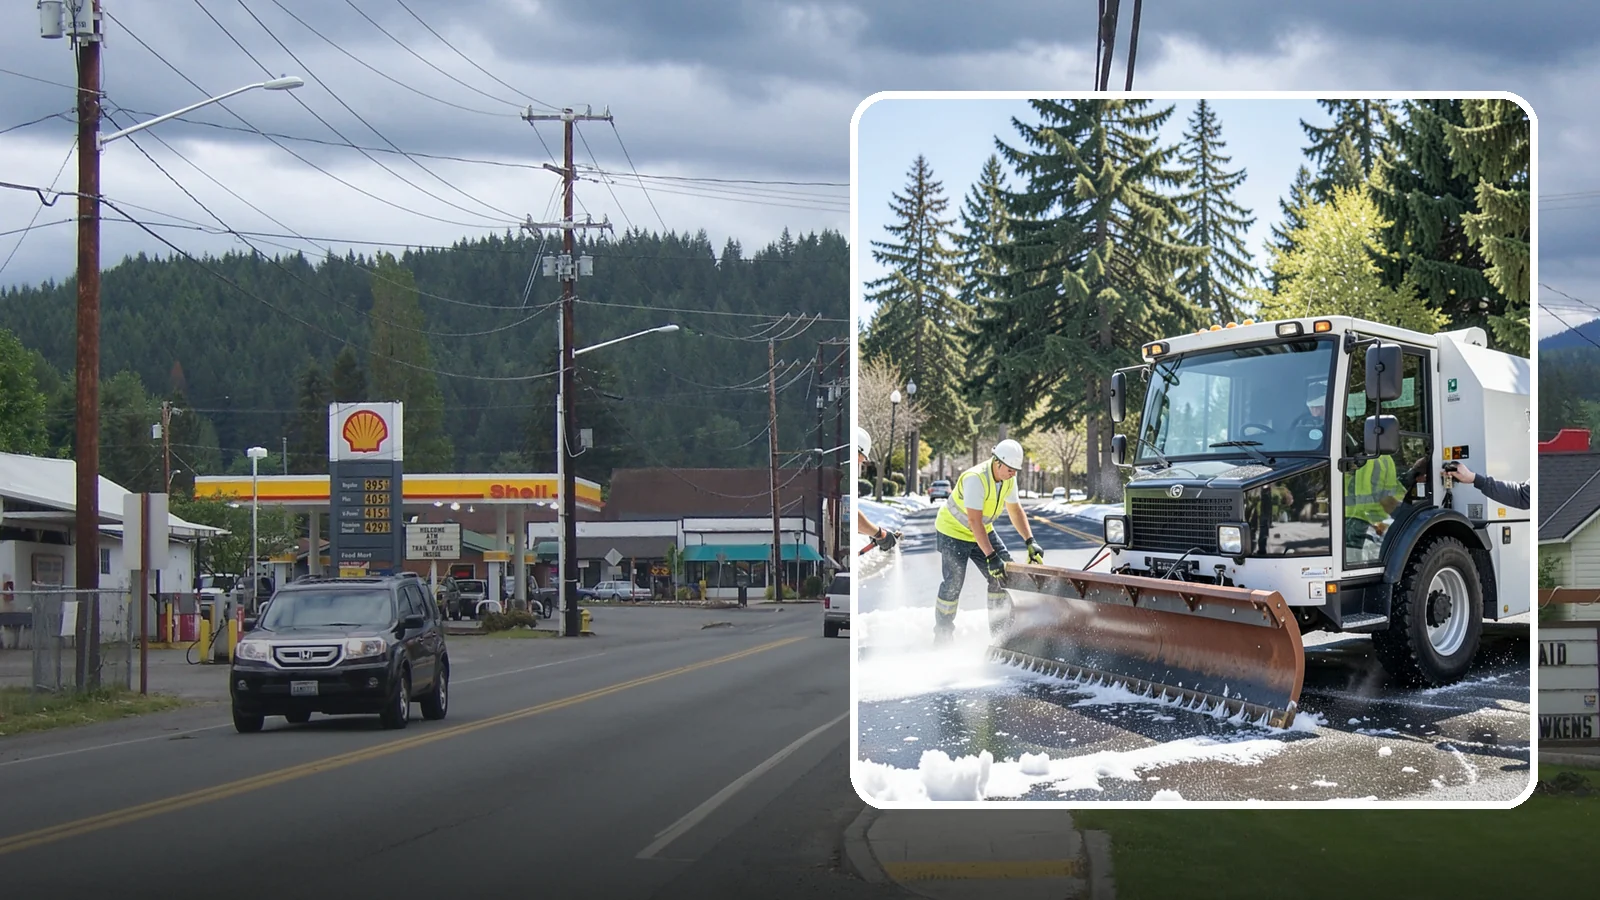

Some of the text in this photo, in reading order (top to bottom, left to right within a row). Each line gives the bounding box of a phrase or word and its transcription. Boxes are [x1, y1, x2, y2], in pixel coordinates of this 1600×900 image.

[366, 480, 383, 490] 395
[490, 484, 548, 499] Shell
[366, 494, 383, 504] 405
[366, 508, 383, 518] 415
[366, 522, 383, 532] 429
